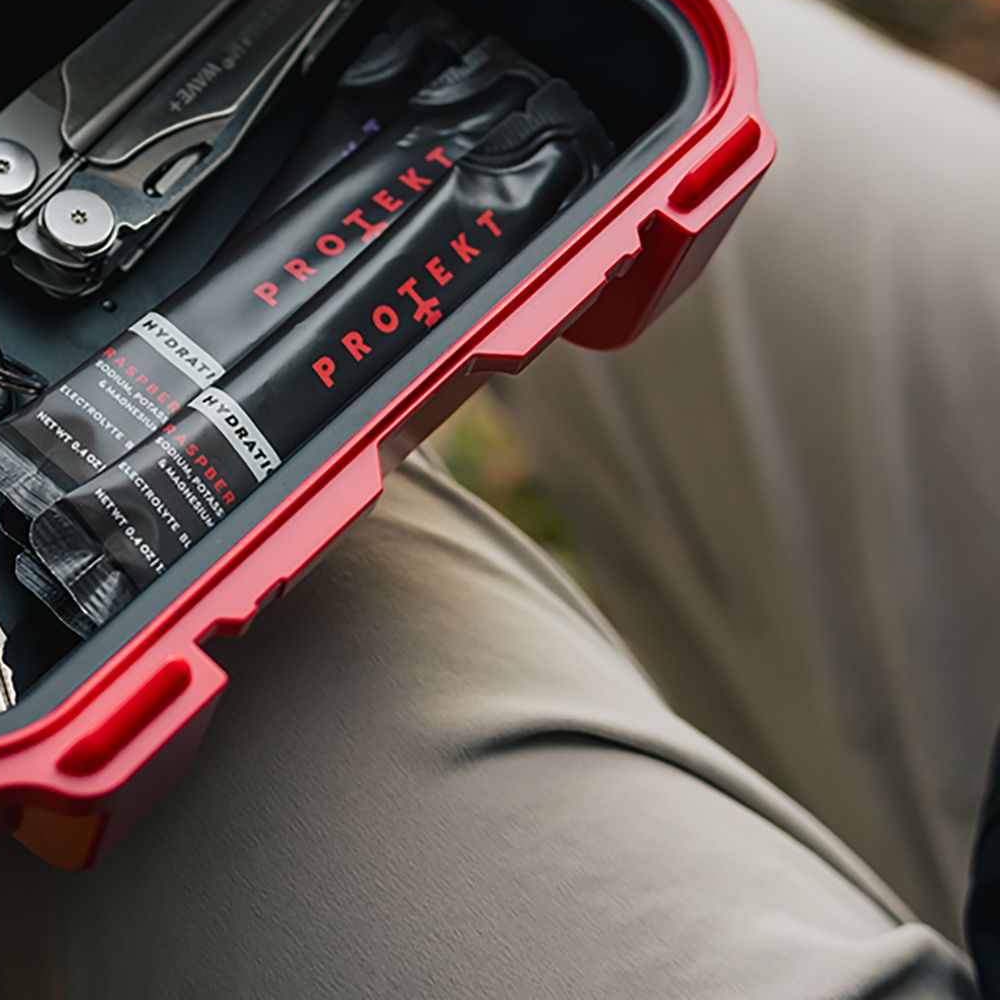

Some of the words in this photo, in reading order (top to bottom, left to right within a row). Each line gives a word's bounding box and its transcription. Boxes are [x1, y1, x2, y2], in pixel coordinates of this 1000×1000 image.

[253, 146, 454, 308] PROTEKT
[311, 208, 504, 389] PROTEKT
[95, 359, 133, 396] SODIUM,
[36, 410, 58, 431] NET
[55, 426, 73, 444] WT
[59, 384, 125, 441] ELECTROLYTE
[155, 436, 192, 479] SODIUM,
[94, 487, 115, 510] NET
[111, 507, 128, 527] WT
[125, 526, 143, 547] 0.4
[118, 460, 181, 532] ELECTROLYTE
[165, 466, 215, 527] MAGNESIUM
